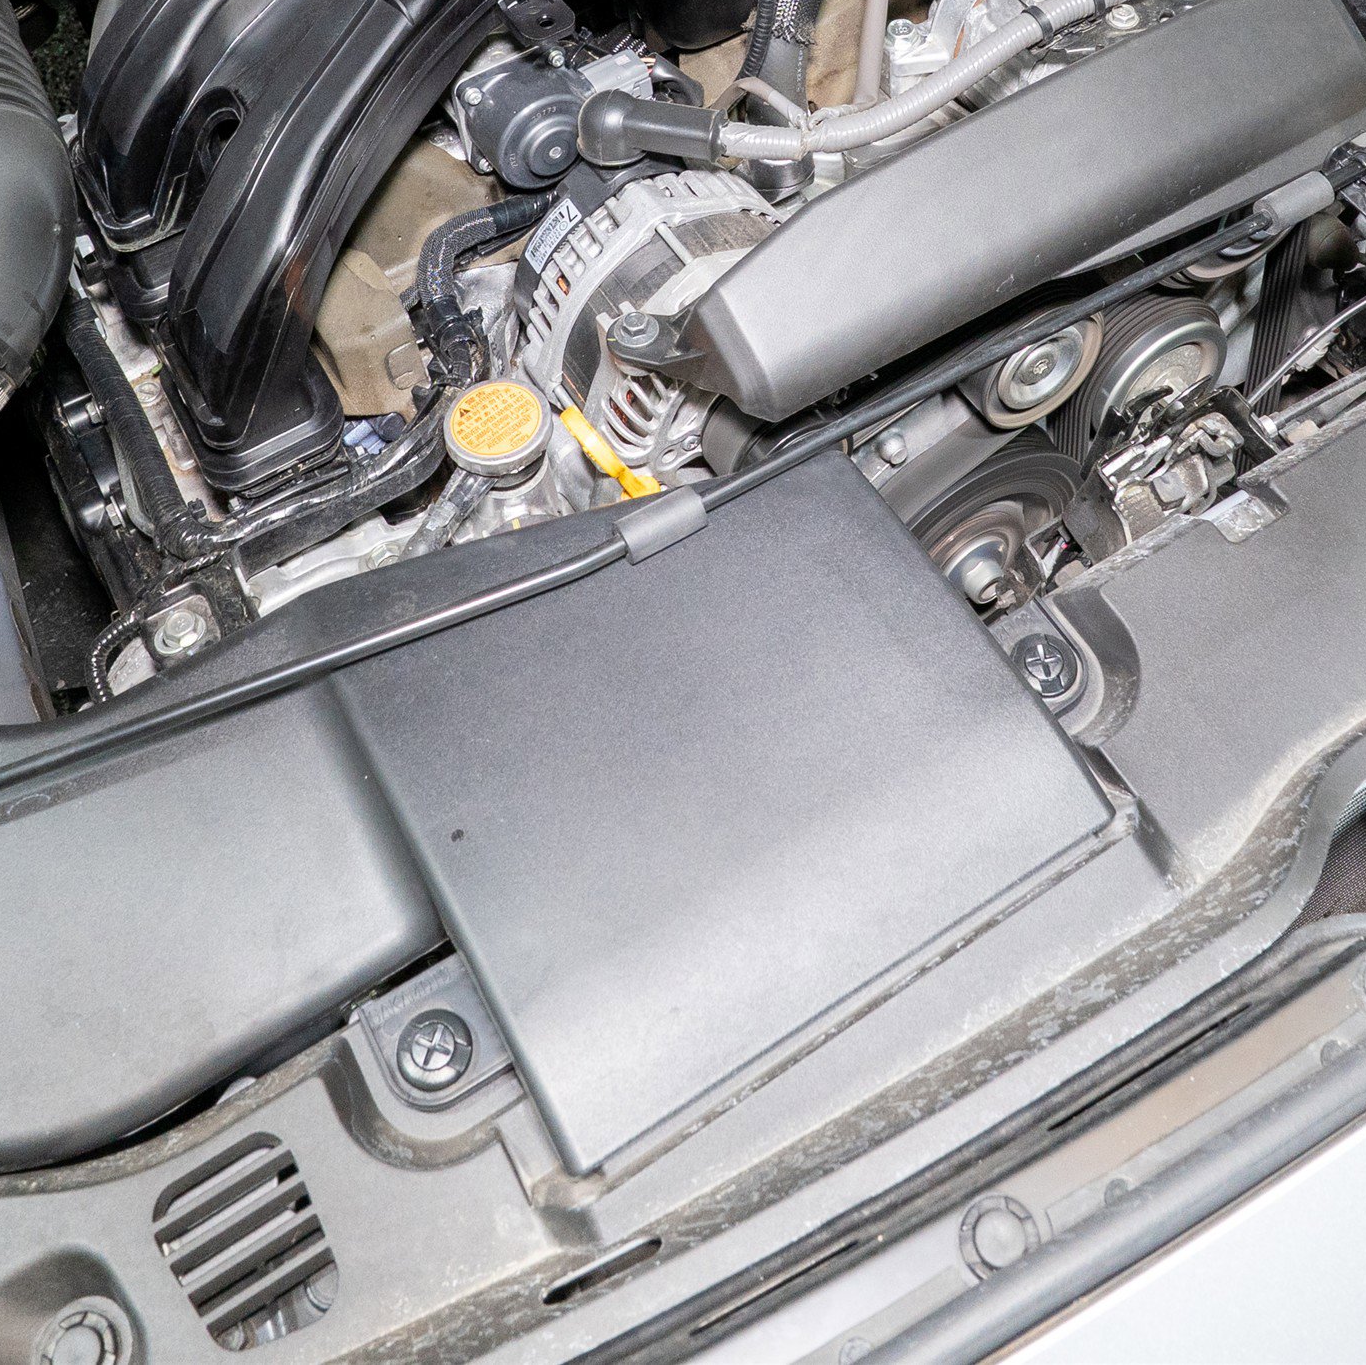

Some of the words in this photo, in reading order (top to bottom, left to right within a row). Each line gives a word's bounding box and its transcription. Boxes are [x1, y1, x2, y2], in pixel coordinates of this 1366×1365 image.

[461, 426, 481, 442] NEVER
[481, 415, 497, 428] OPEN
[496, 403, 514, 418] WHEN
[486, 414, 532, 449] AVERTISSEMENT
